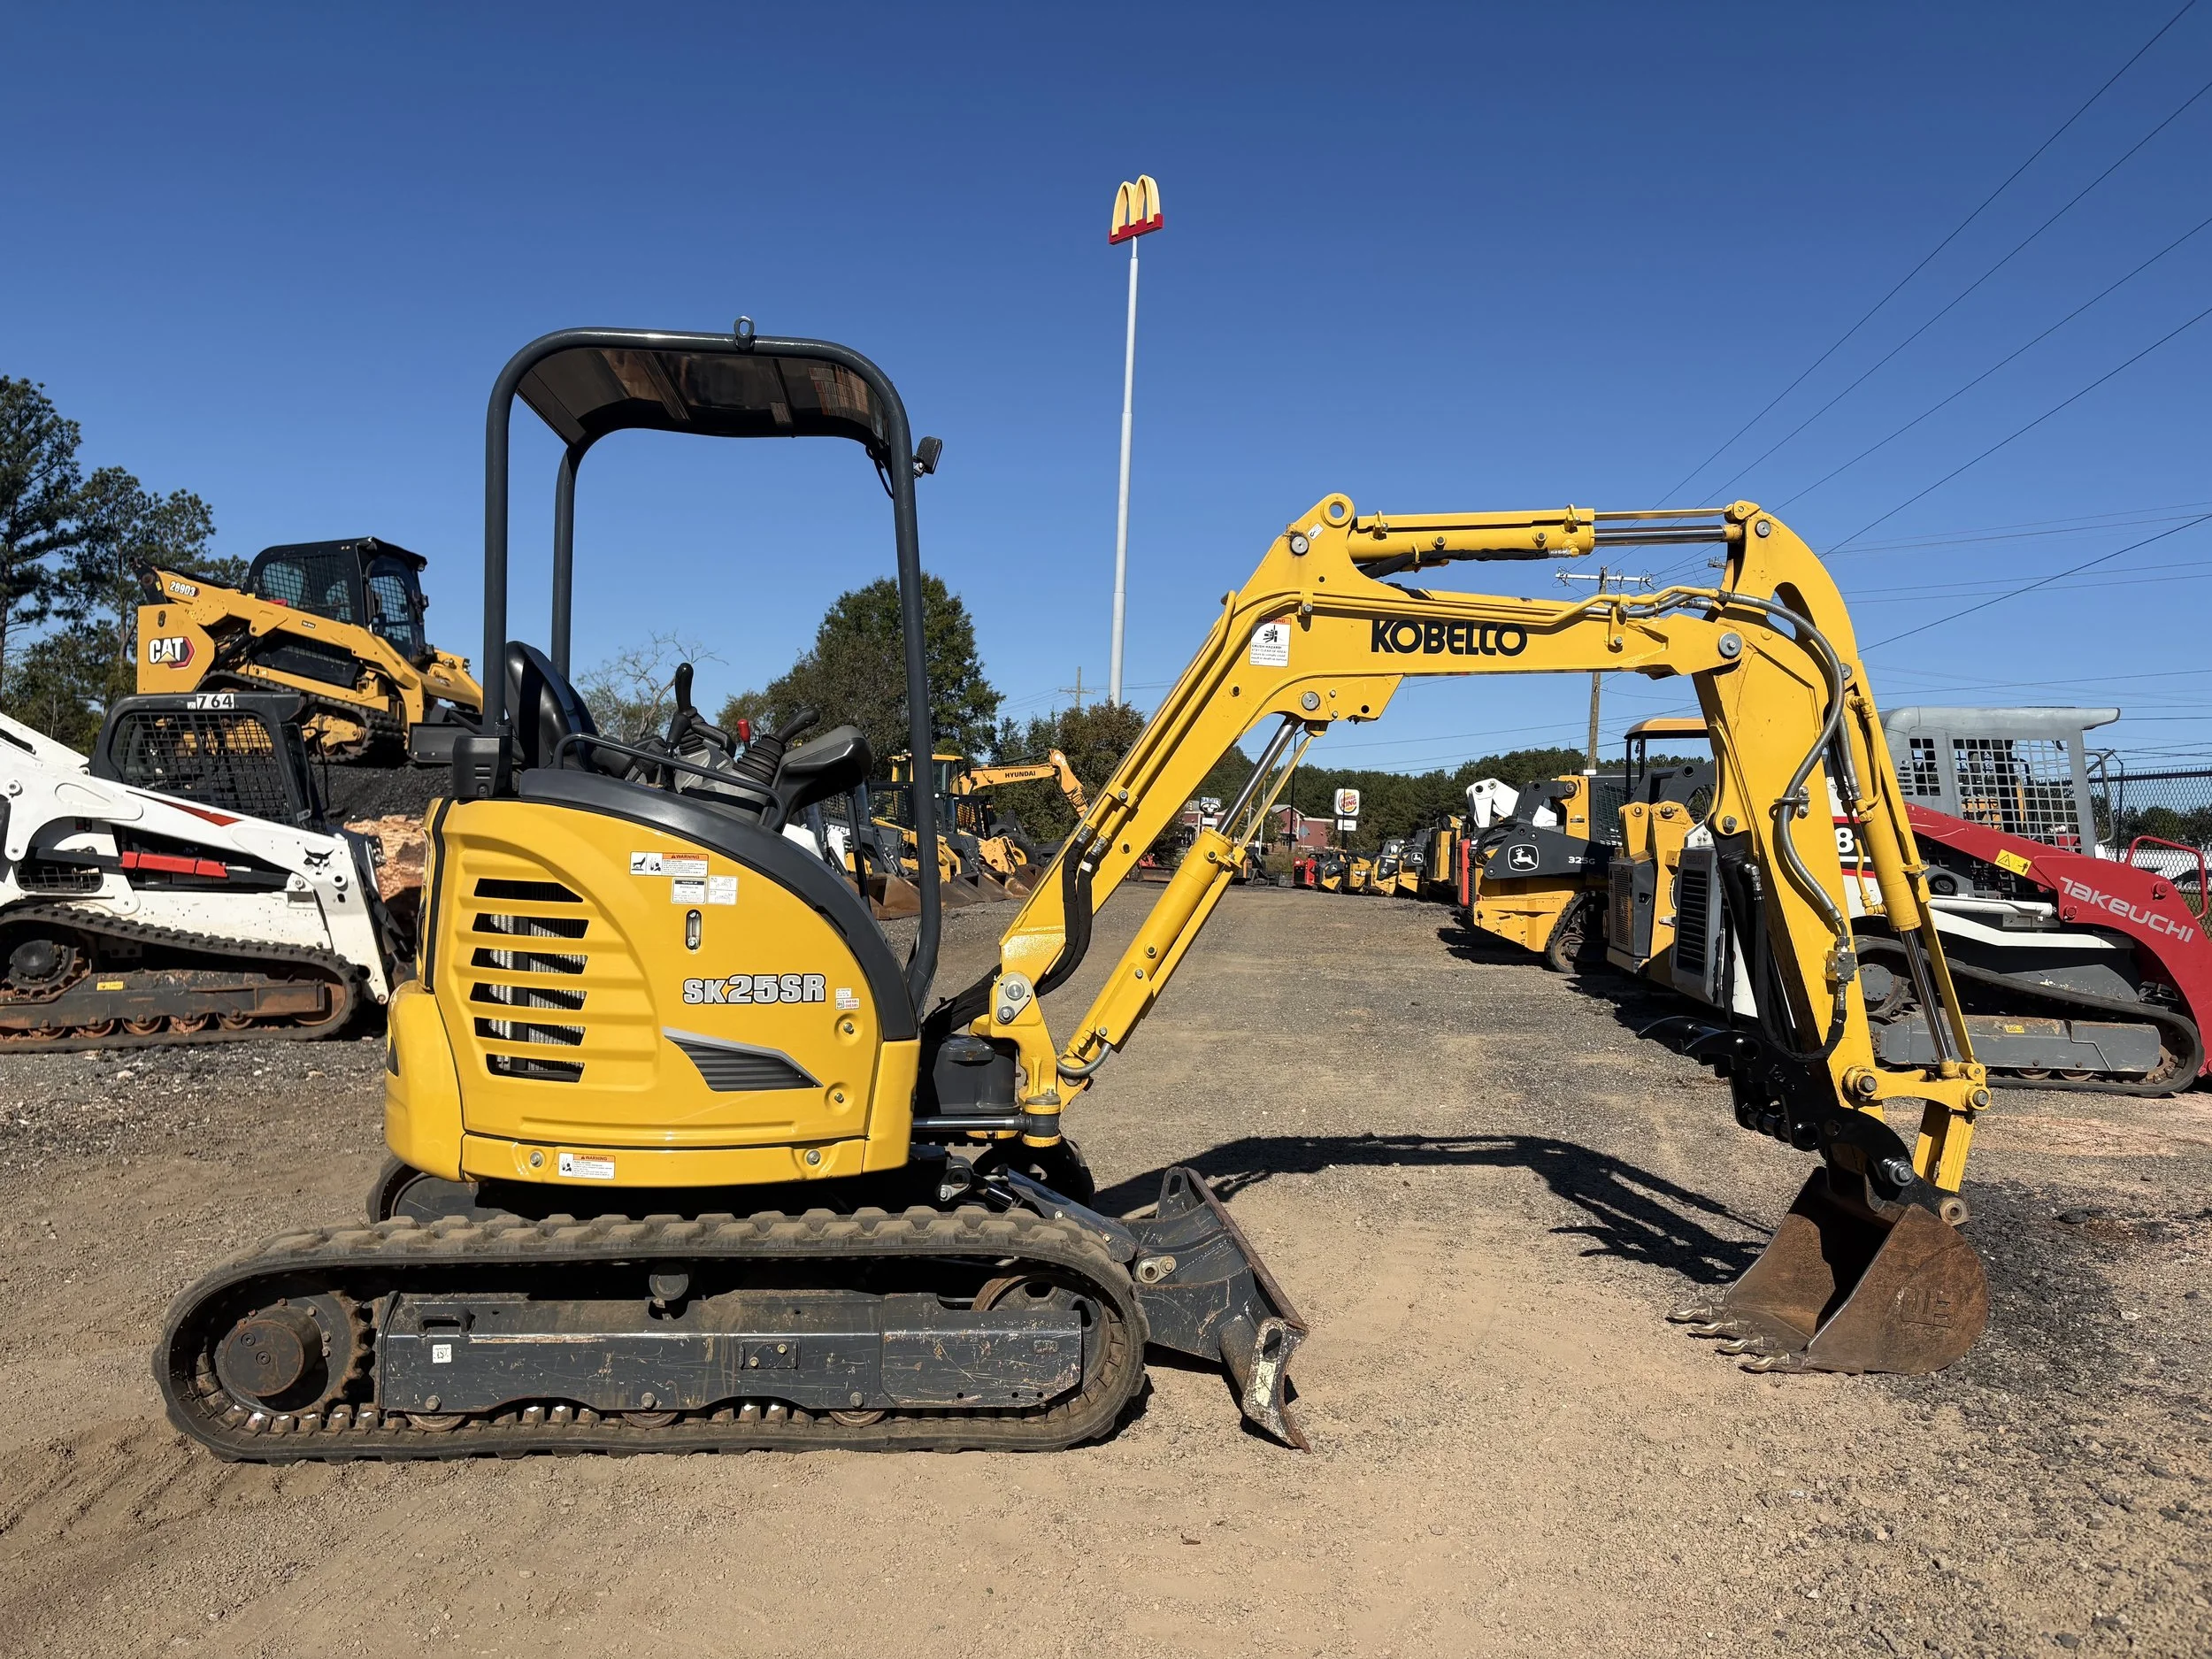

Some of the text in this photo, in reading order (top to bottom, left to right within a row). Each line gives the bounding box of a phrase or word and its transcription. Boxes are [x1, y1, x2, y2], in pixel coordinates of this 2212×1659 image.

[169, 580, 196, 597] 289D3
[1371, 618, 1527, 657] KOBELCO
[149, 636, 184, 664] CAT
[197, 695, 233, 709] 764
[1004, 770, 1036, 779] HYUNDAI
[1568, 856, 1596, 864] 325G
[683, 973, 826, 1004] SK25SR
